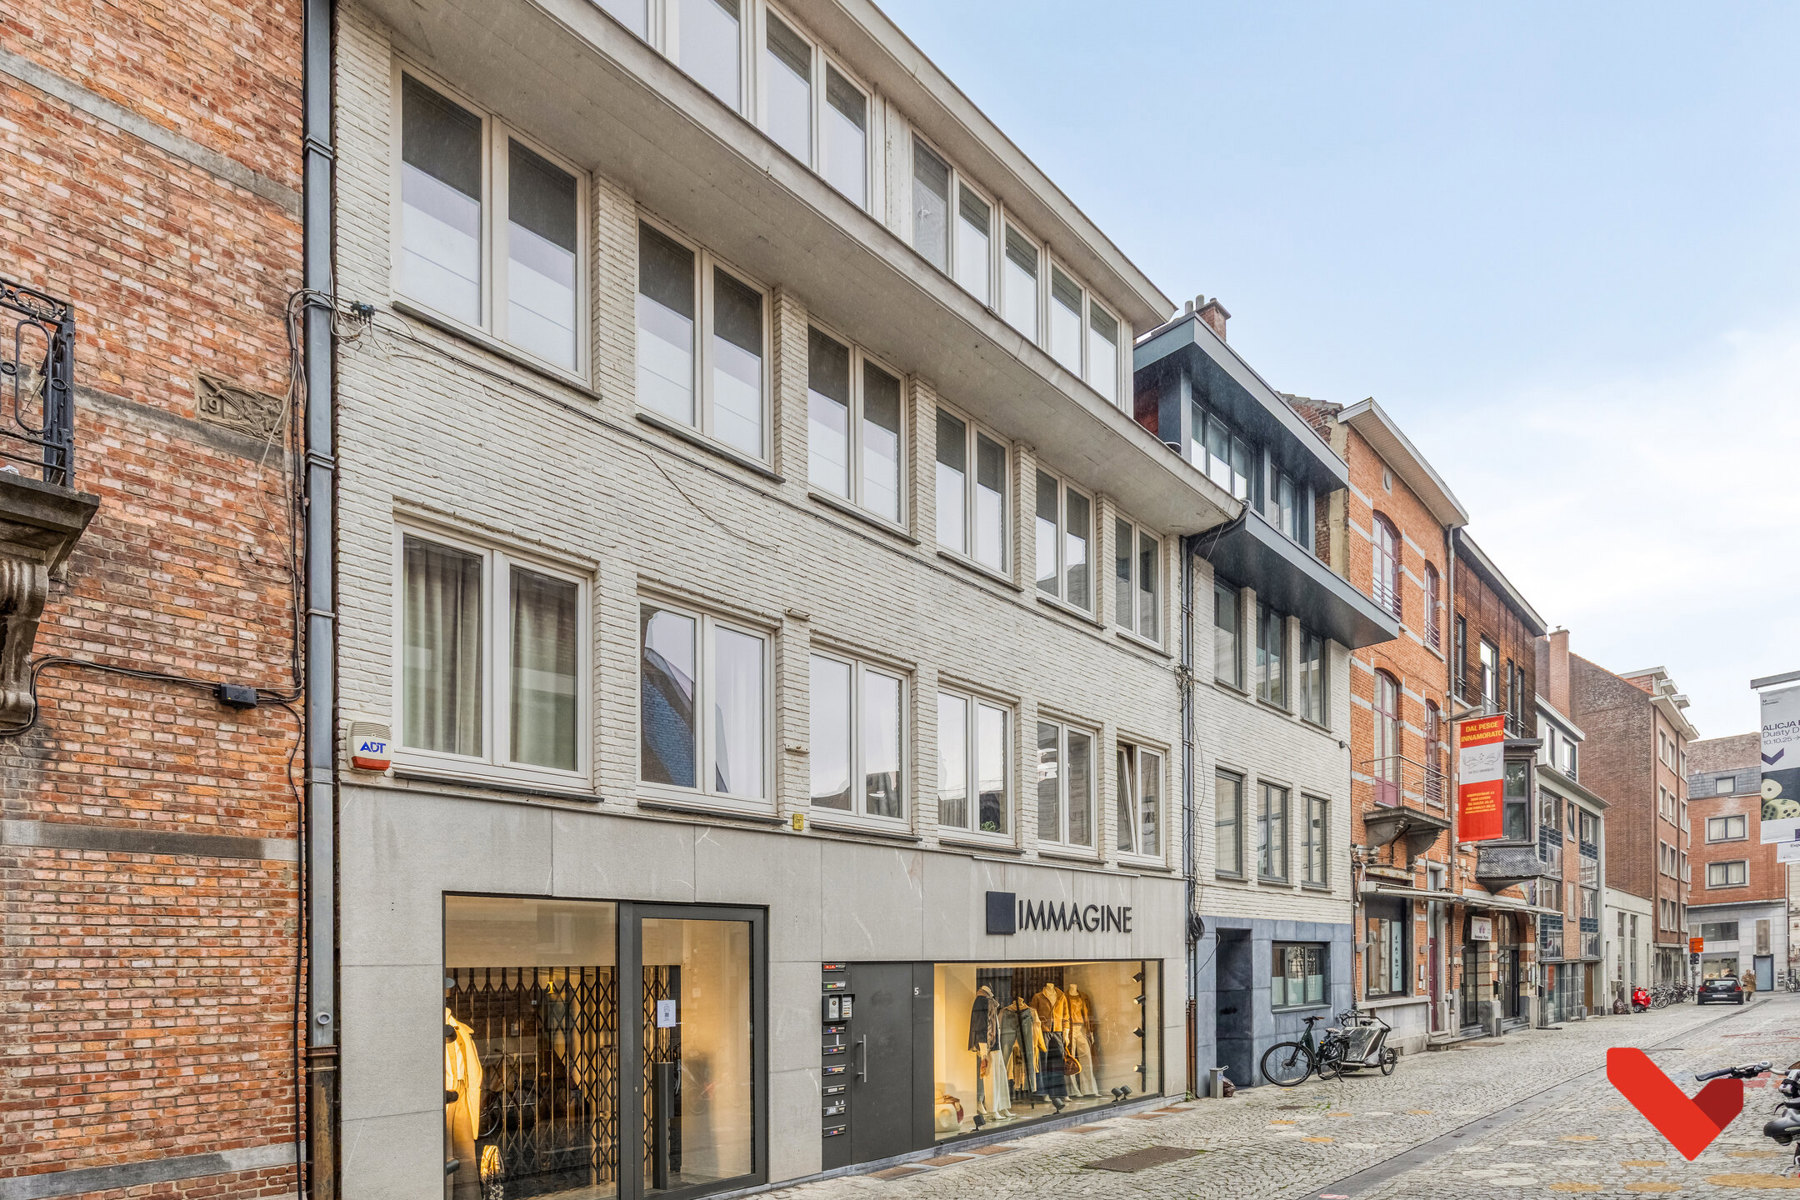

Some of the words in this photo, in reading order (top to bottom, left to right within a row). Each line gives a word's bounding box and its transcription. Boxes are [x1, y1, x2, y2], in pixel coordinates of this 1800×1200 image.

[1479, 721, 1498, 730] PESCE
[1762, 720, 1797, 732] ALICJA
[1461, 730, 1503, 742] INNAMORATO
[1762, 729, 1790, 738] Dusty
[360, 741, 386, 754] ADT
[1018, 899, 1133, 933] IMMAGINE
[914, 987, 920, 996] 5
